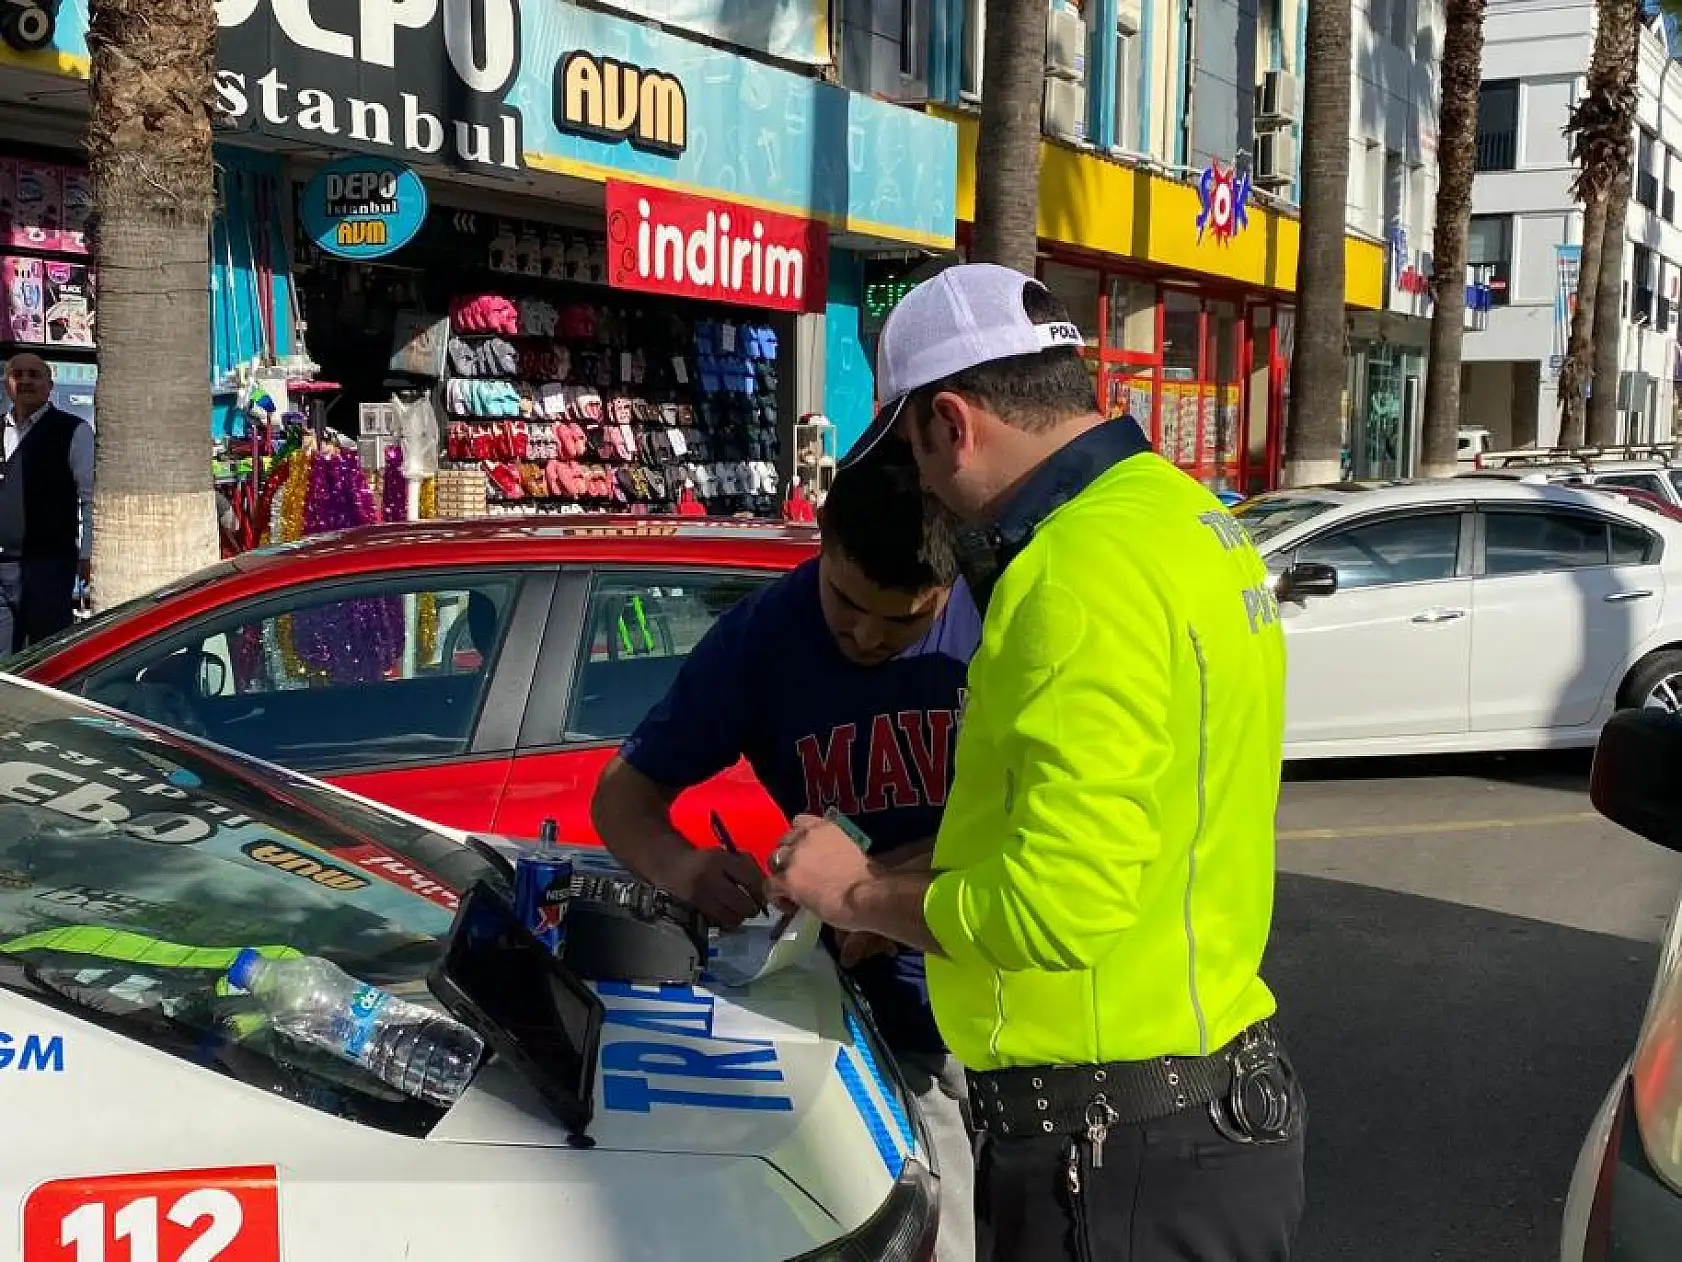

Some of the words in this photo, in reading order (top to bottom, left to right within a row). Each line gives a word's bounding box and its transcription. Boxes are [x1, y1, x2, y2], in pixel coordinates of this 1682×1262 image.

[213, 67, 520, 170] stanbul
[566, 56, 684, 146] AVM
[326, 171, 397, 200] DEPO
[339, 220, 385, 244] AVM
[638, 198, 803, 298] indirim
[795, 687, 968, 816] MAV
[61, 1188, 243, 1262] 112
